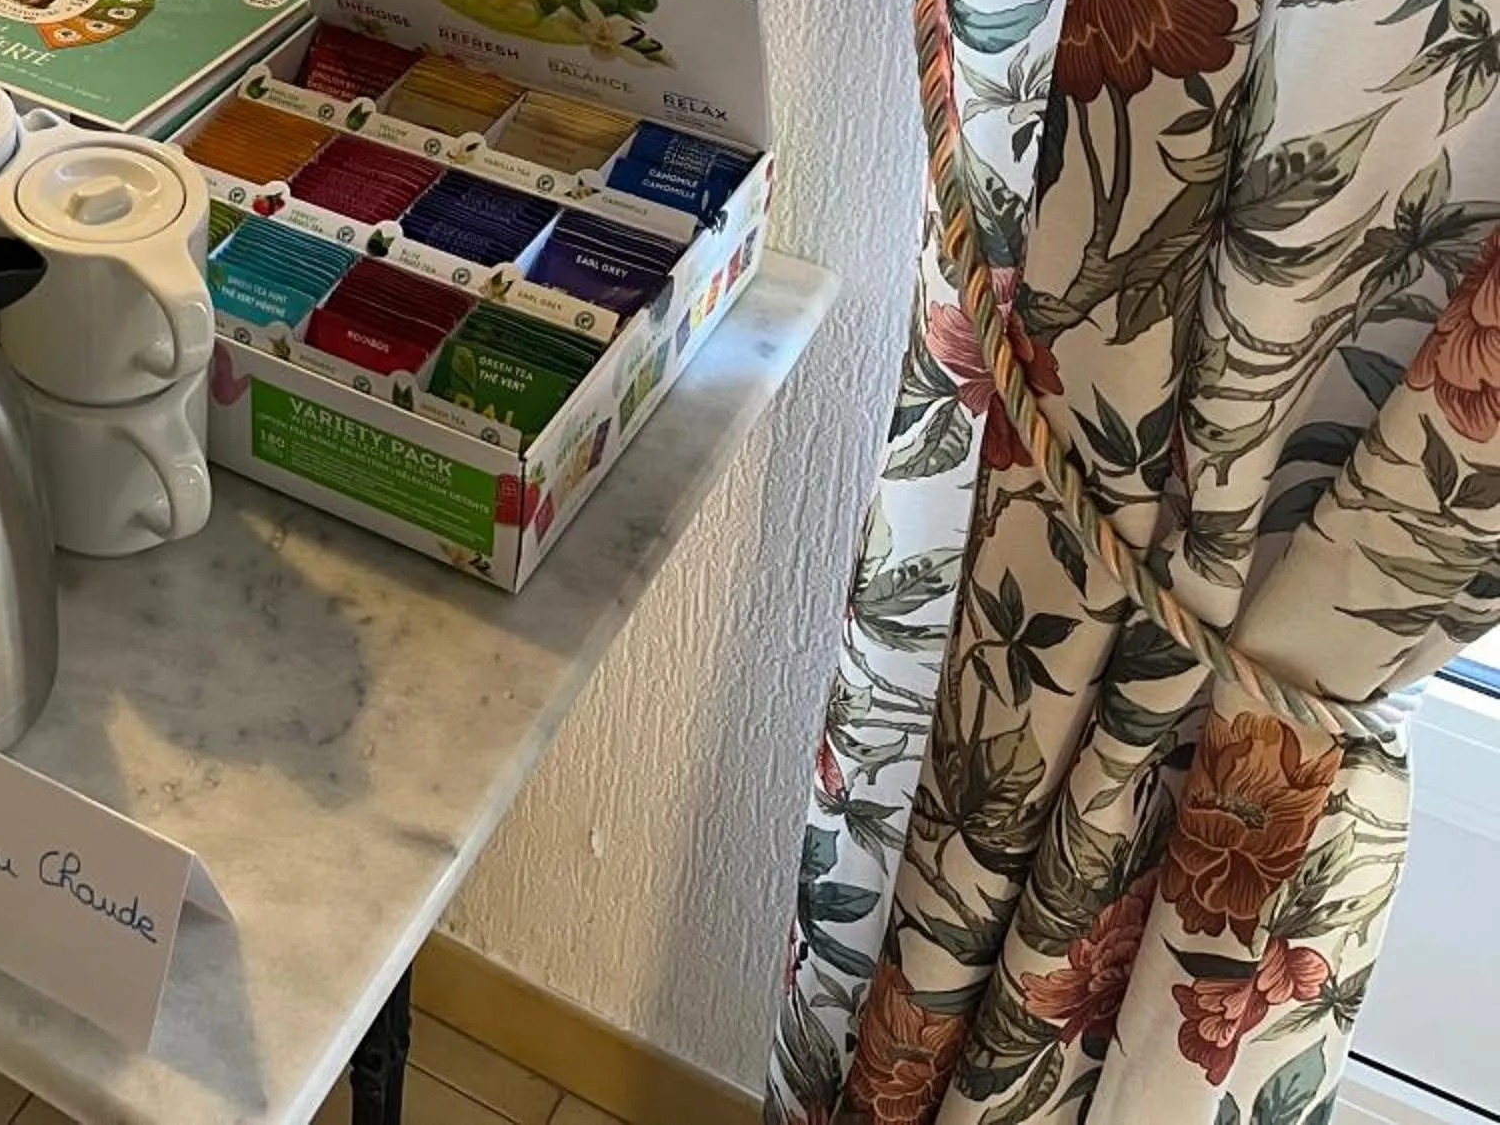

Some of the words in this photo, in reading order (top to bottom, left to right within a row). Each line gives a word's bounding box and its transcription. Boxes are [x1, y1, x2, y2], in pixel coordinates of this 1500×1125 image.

[438, 27, 519, 60] REFRESH
[547, 58, 631, 94] BALANCE
[662, 91, 728, 121] RELAX
[575, 253, 600, 272] EARL
[601, 261, 629, 280] GREY
[479, 355, 514, 374] GREEN
[515, 365, 534, 382] TEA
[500, 377, 526, 394] VERT
[290, 395, 388, 449] VARIETY
[390, 440, 453, 477] PACK
[38, 851, 157, 944] Chaude
